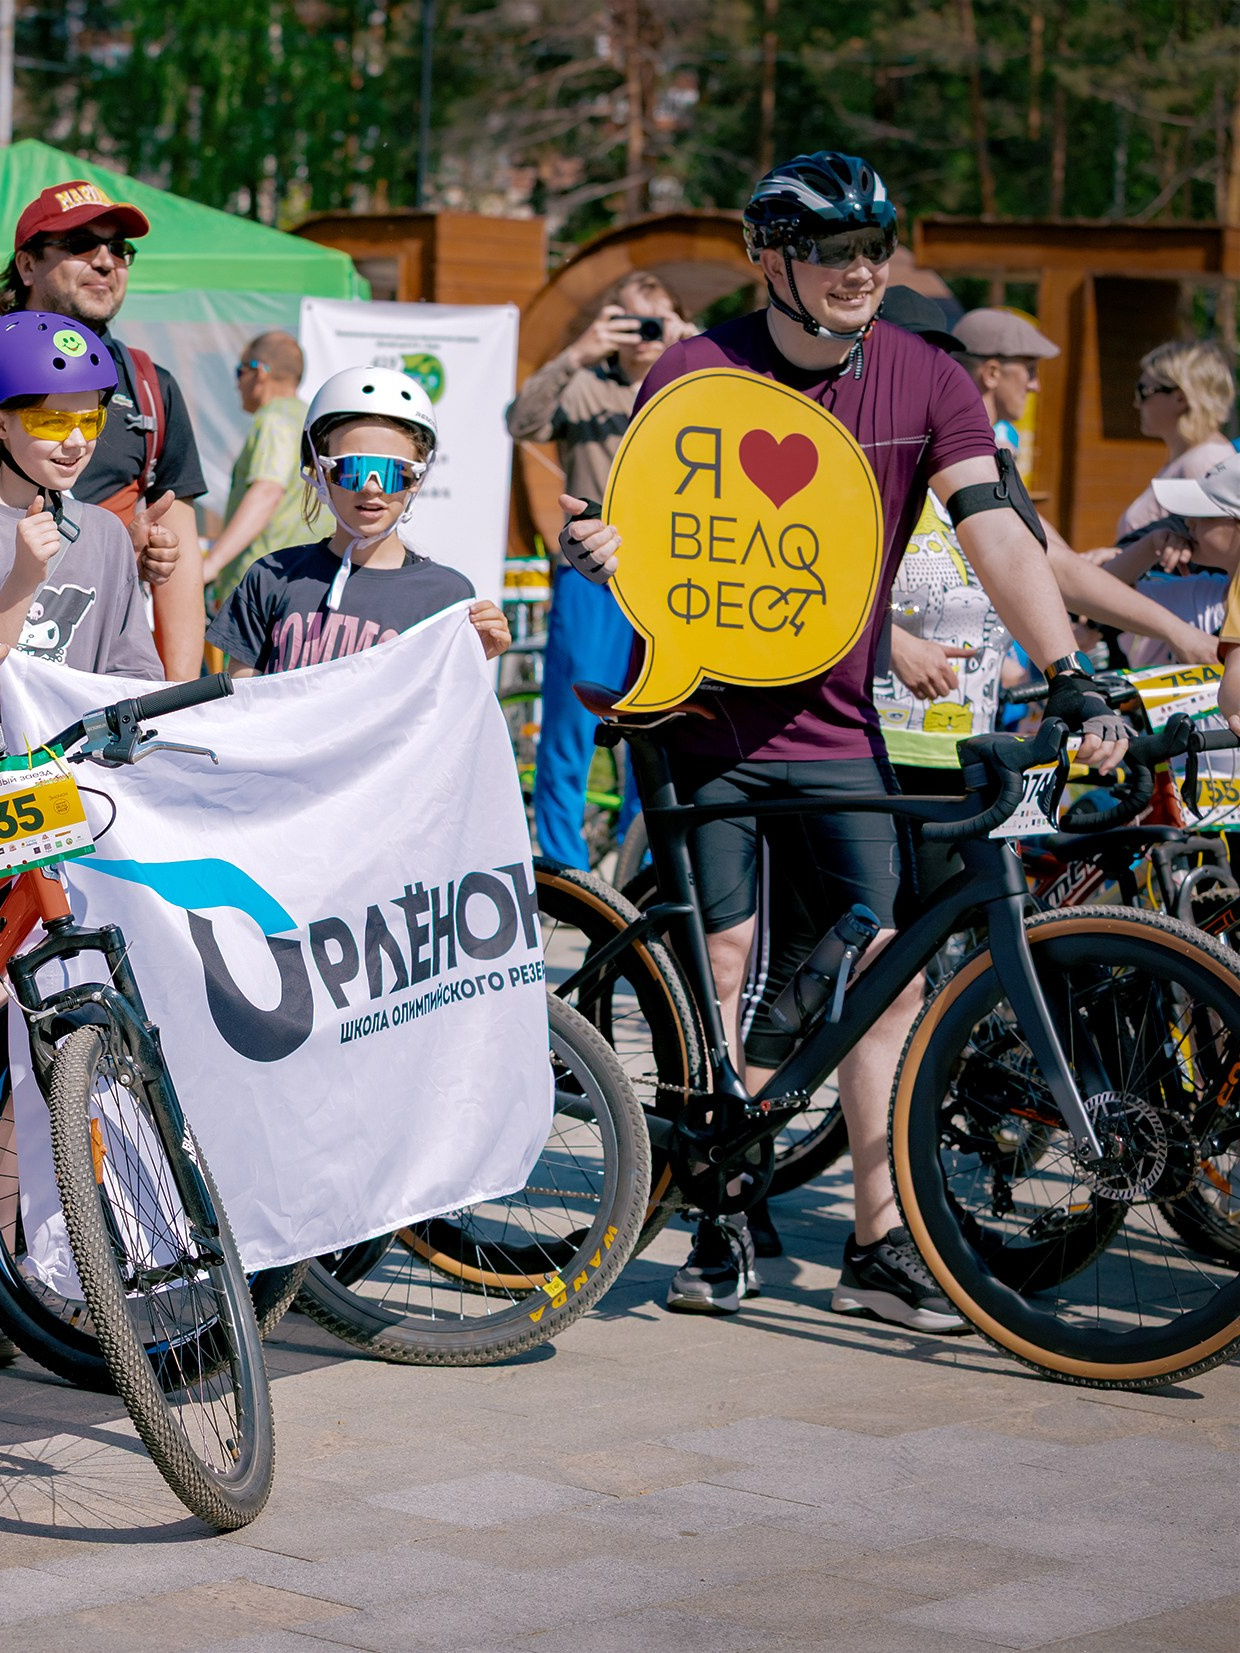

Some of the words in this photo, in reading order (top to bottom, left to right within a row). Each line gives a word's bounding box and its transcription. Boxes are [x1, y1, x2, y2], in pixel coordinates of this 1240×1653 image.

[674, 425, 722, 499] Я
[671, 511, 822, 585] ВЕЛО
[667, 577, 827, 637] ФЕСТ
[19, 769, 53, 782] заезд
[340, 1009, 390, 1045] ШКОЛА
[392, 971, 505, 1027] ОЛИМПИЙСКОГО
